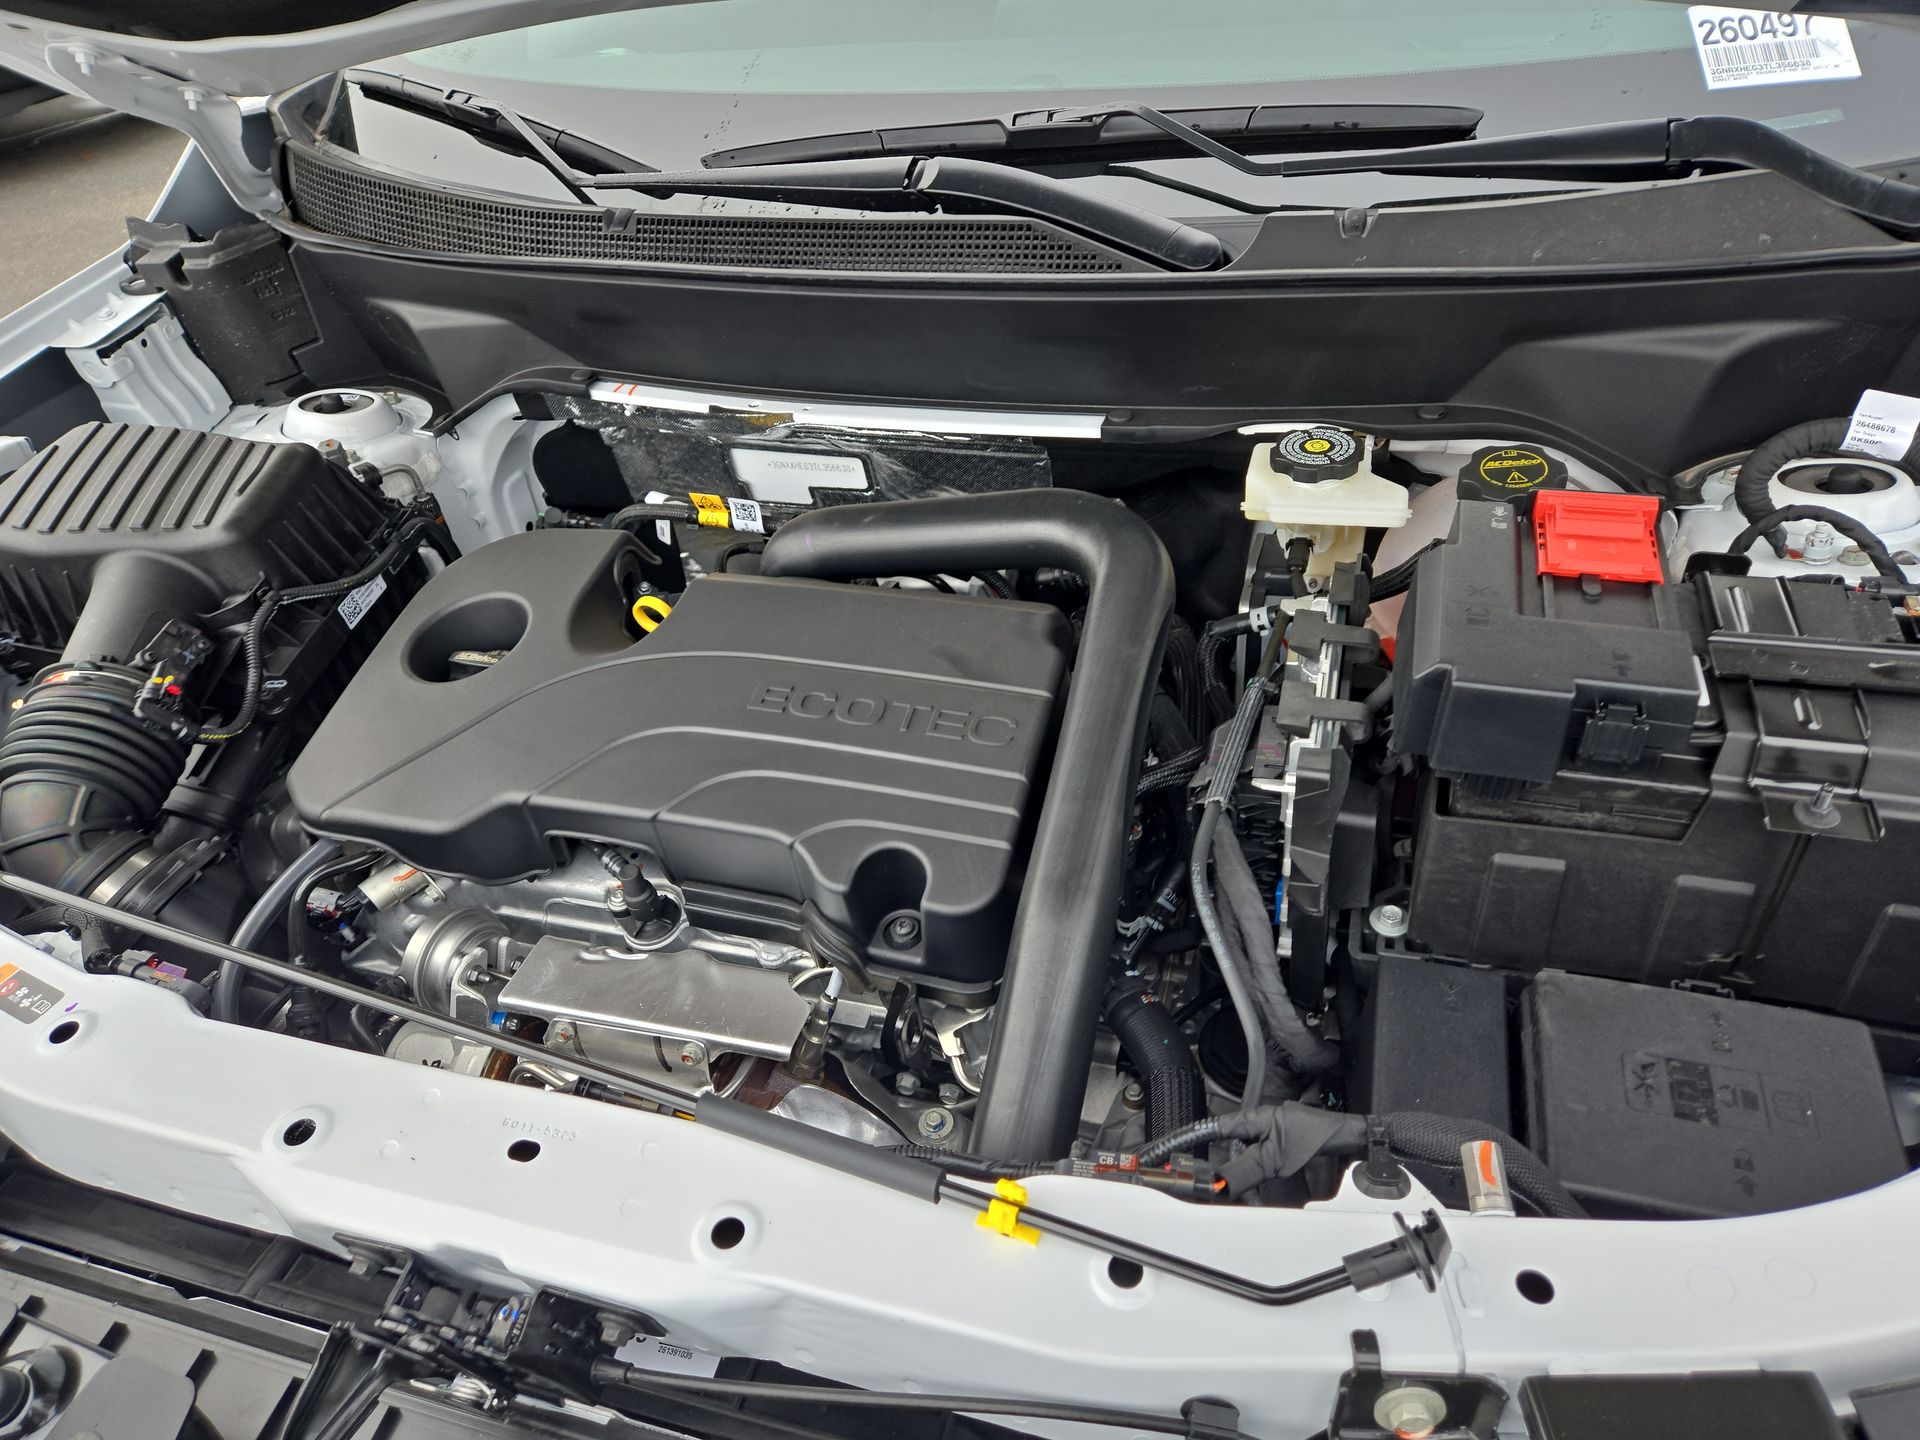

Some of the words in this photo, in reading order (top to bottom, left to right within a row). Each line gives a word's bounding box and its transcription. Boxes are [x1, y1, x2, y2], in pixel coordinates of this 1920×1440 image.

[1698, 13, 1814, 45] 260497
[1484, 459, 1542, 468] ACDelco
[453, 652, 499, 664] ACDelco
[746, 680, 1017, 747] ECOTEC
[657, 1345, 693, 1360] 261391035
